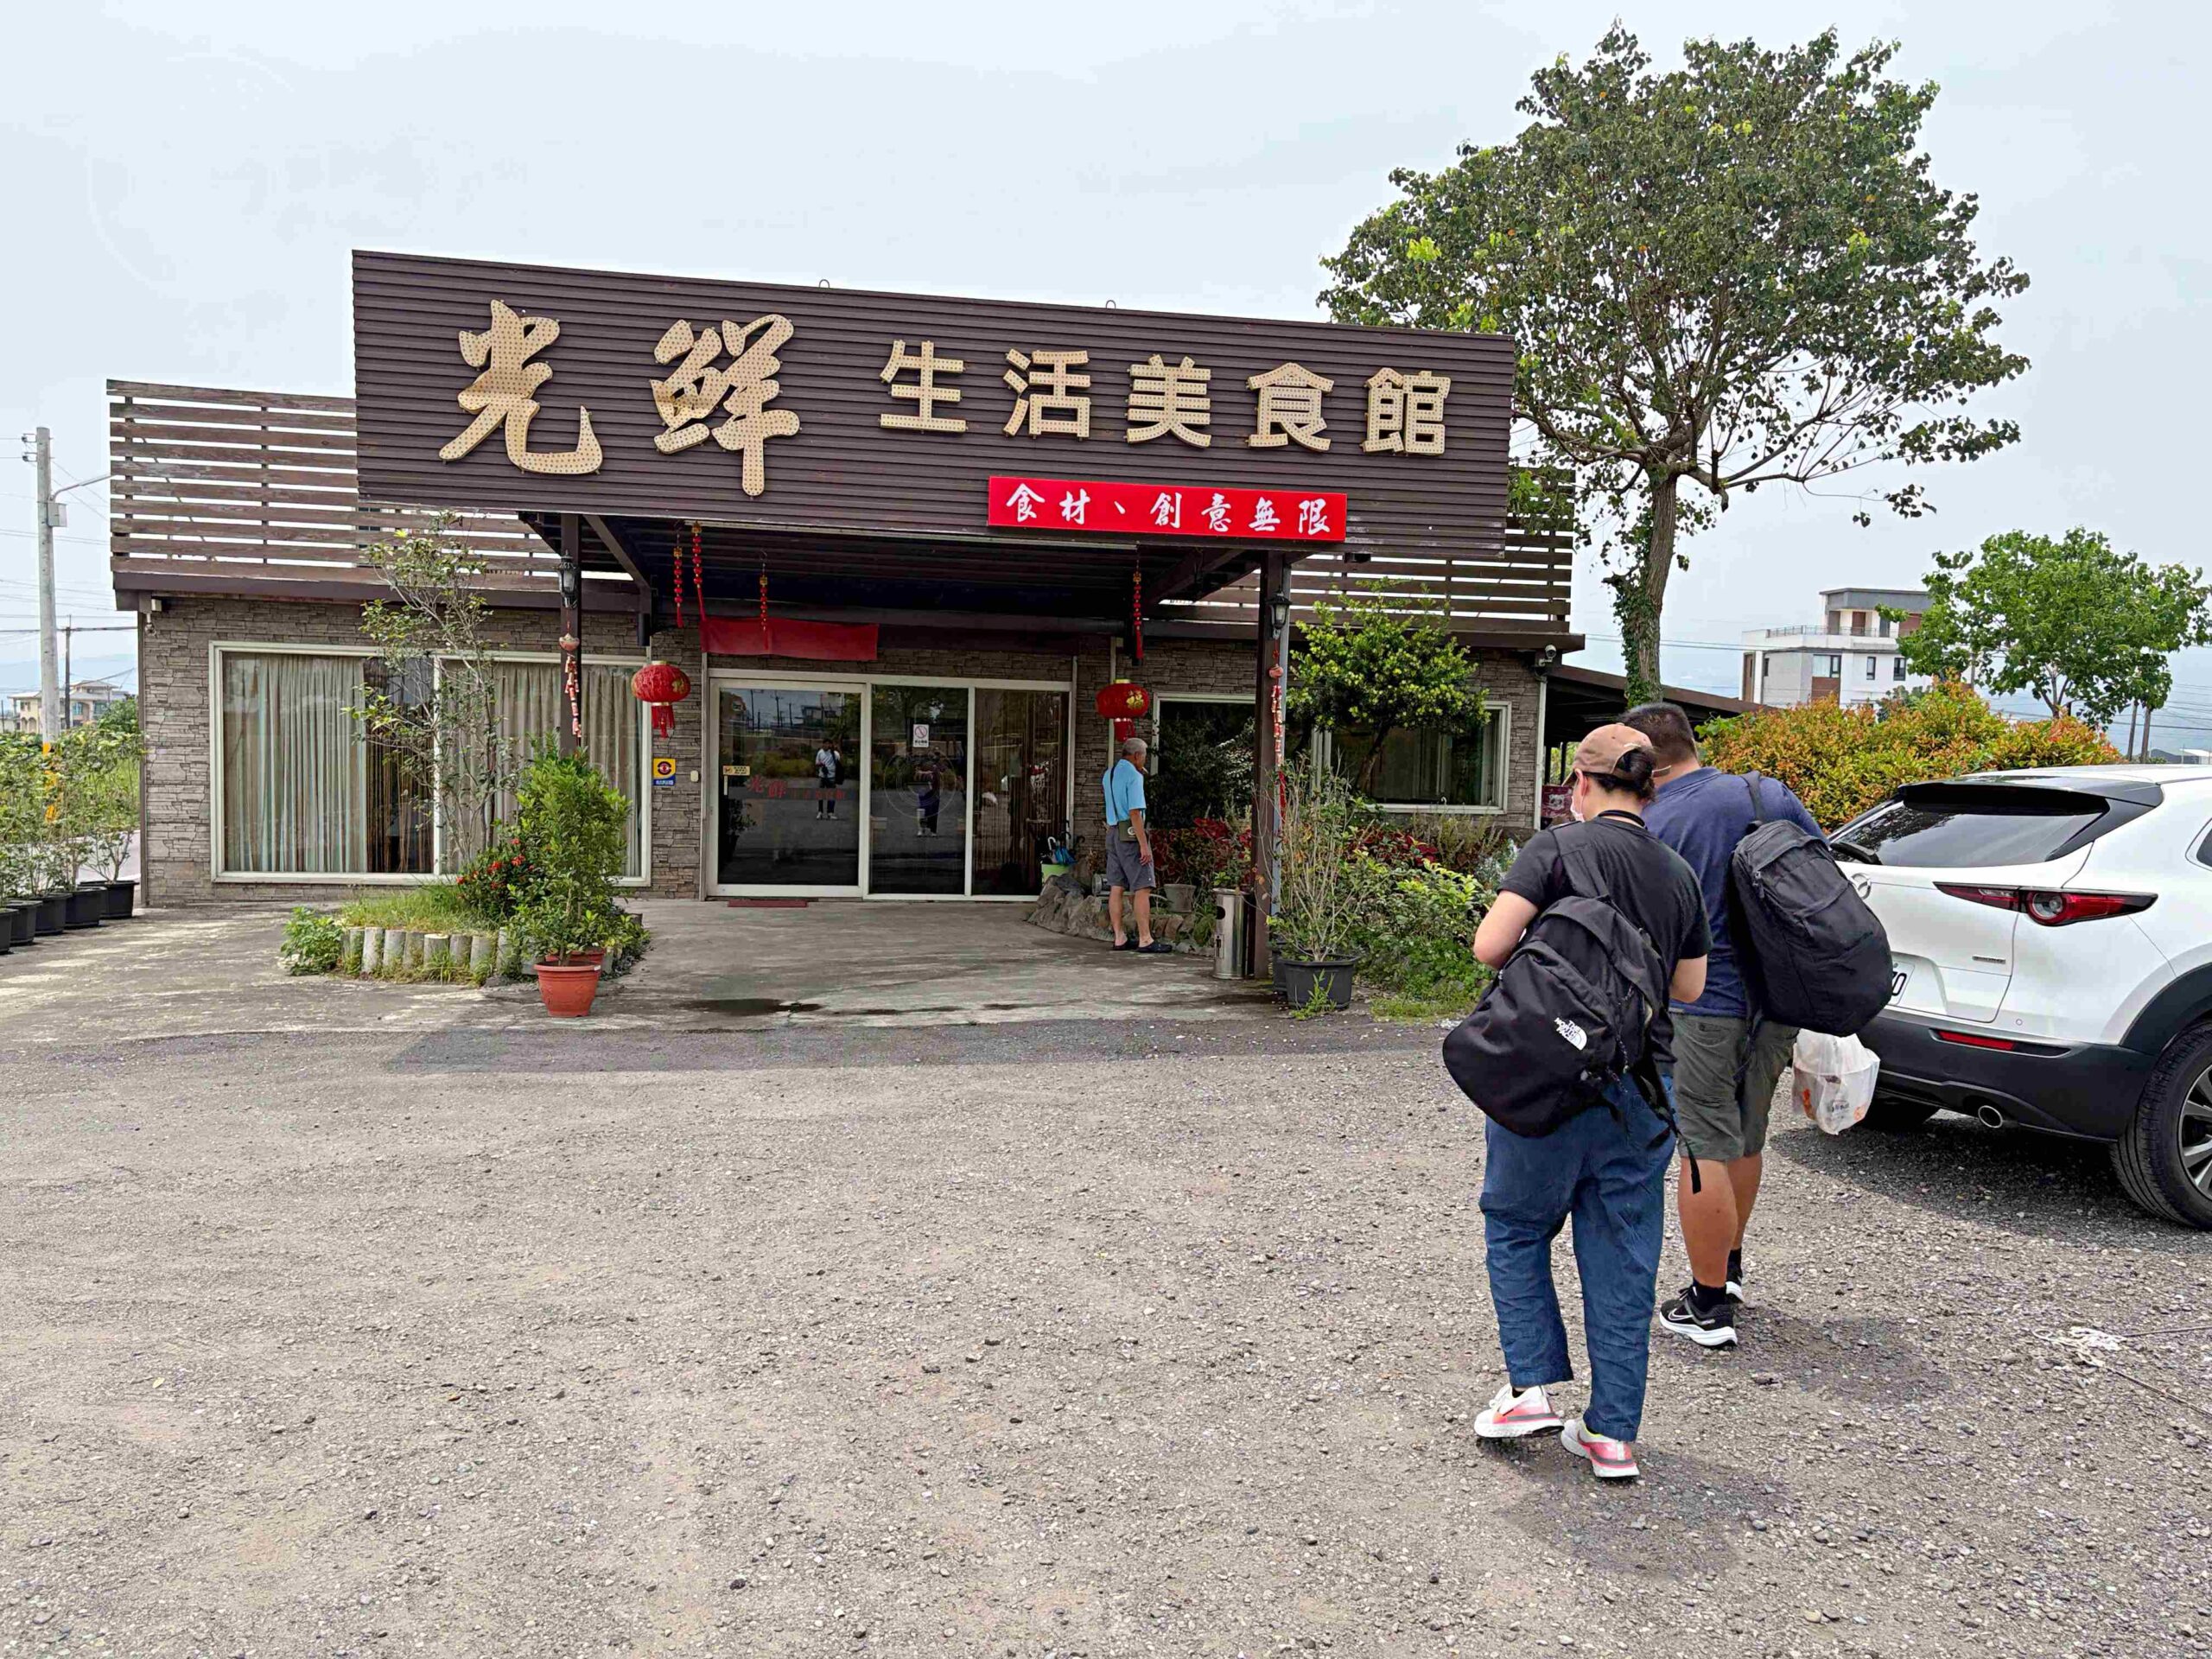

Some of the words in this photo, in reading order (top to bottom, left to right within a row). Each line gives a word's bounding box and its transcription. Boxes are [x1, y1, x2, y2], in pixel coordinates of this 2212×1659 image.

[1007, 483, 1331, 536] 食材、創意無限
